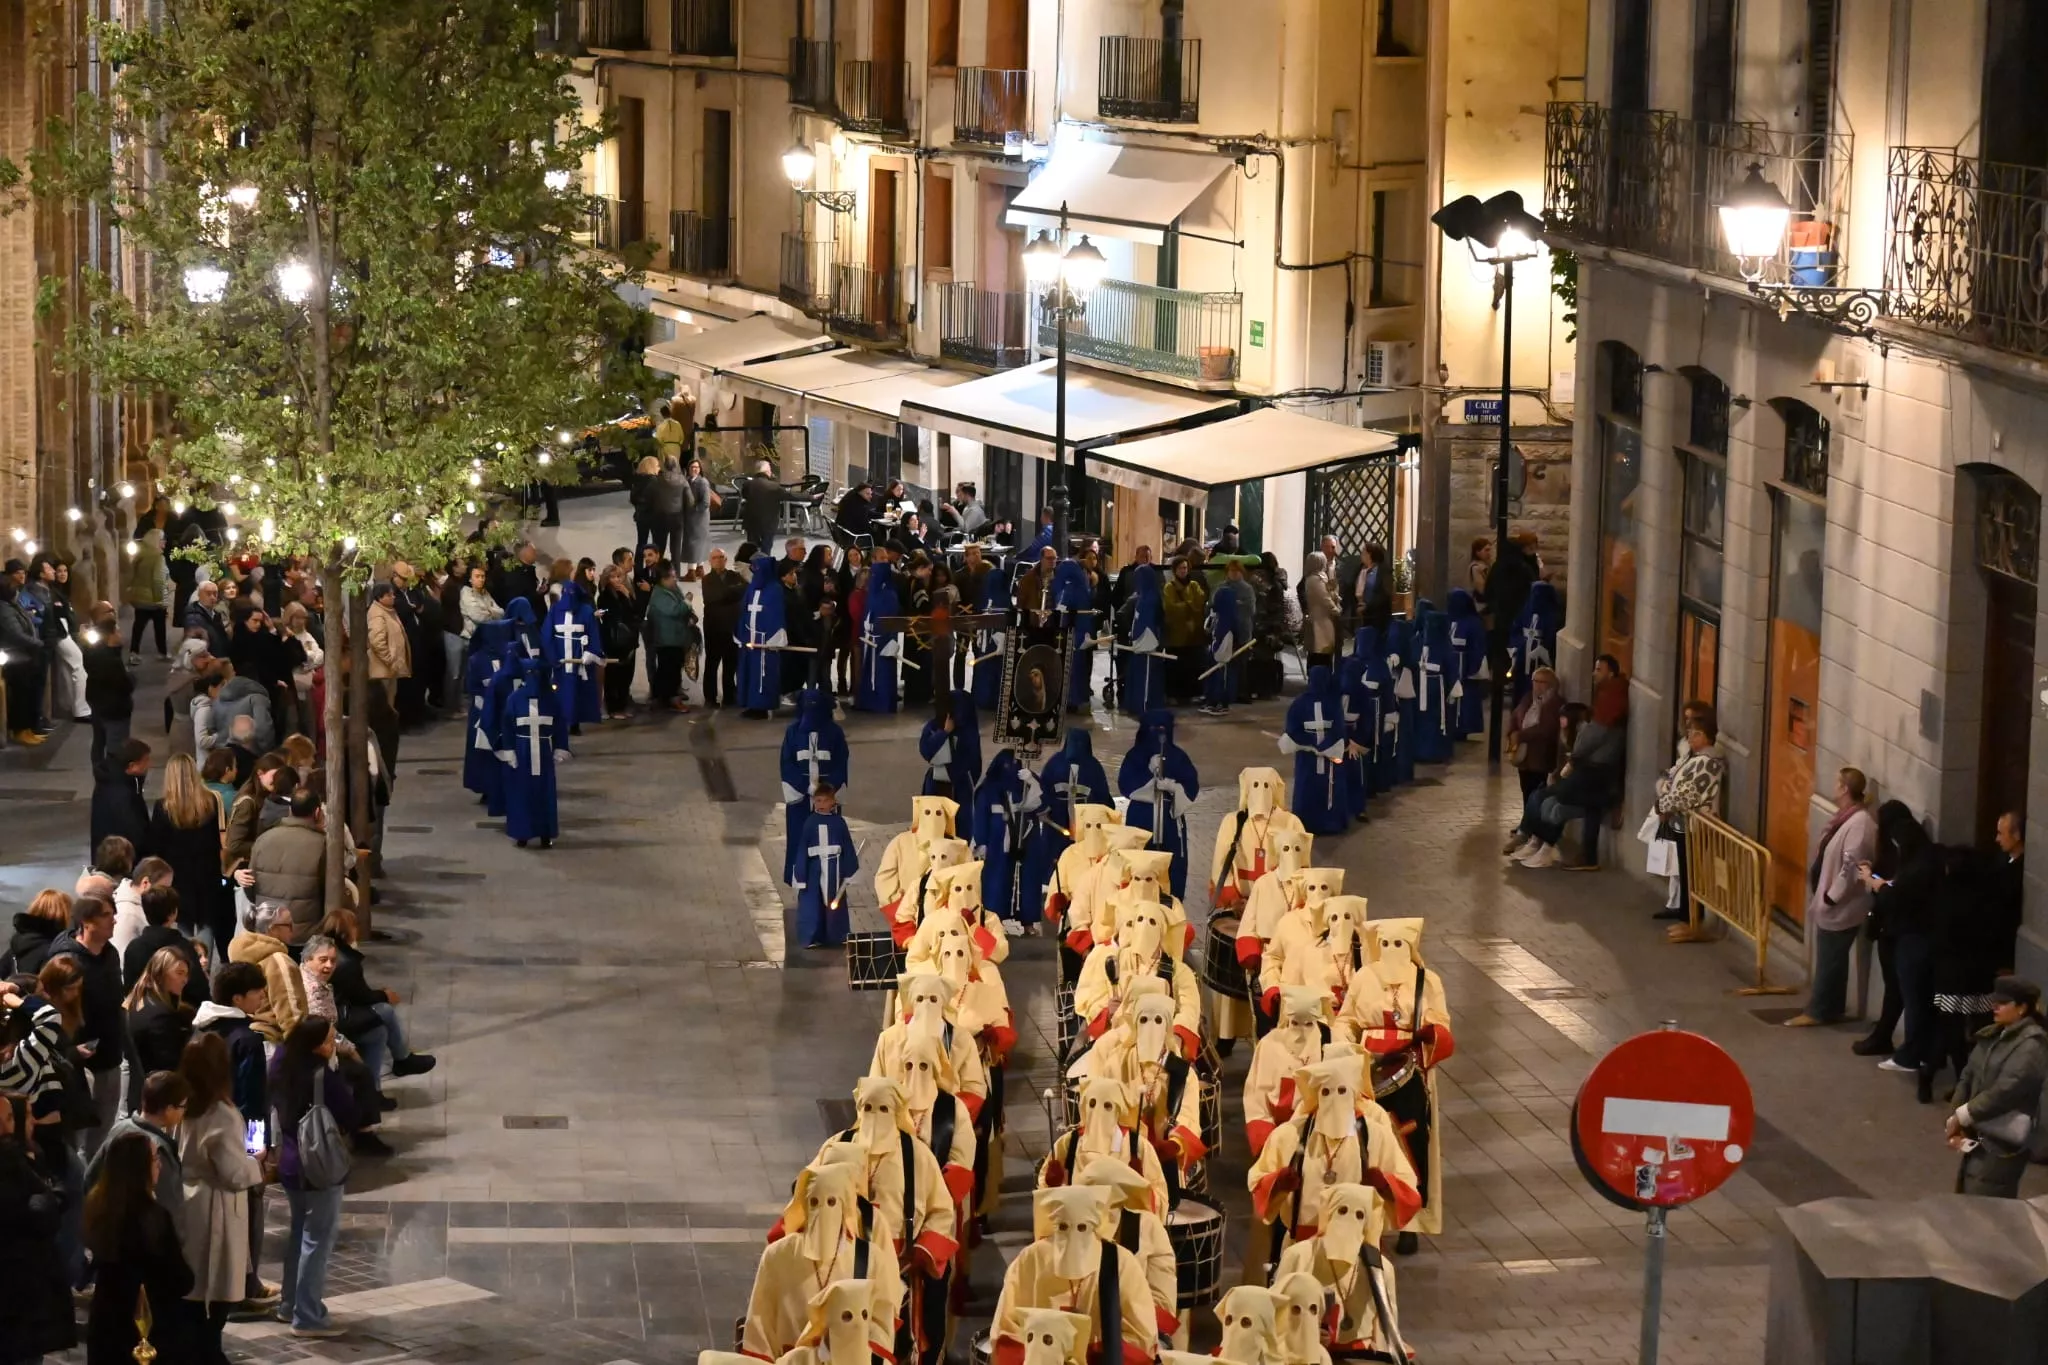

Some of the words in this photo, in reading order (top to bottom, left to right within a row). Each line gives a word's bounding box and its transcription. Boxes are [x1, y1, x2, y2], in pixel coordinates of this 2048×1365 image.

[1475, 401, 1497, 409] CALLE
[1466, 415, 1479, 424] SAN
[1480, 415, 1501, 424] ORENC
